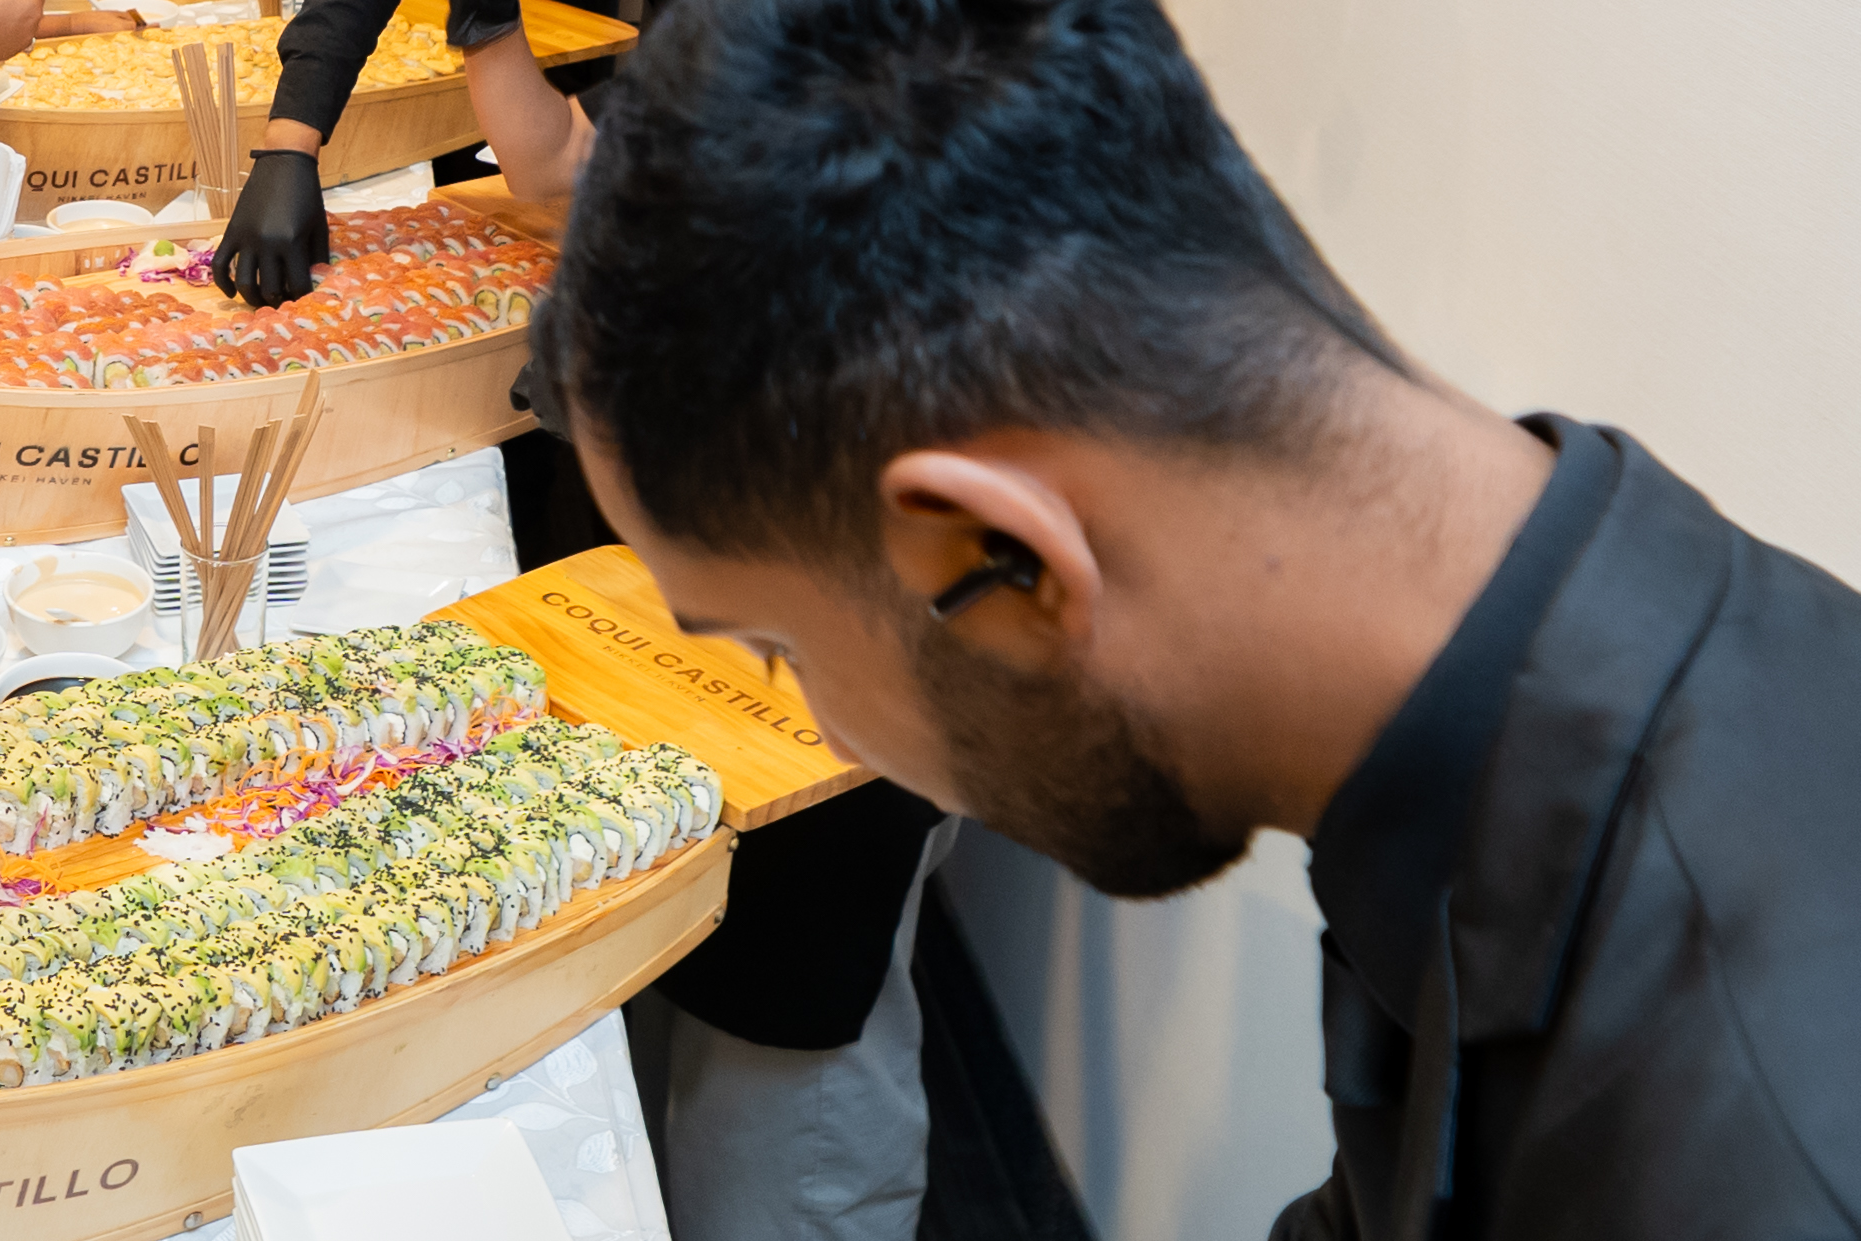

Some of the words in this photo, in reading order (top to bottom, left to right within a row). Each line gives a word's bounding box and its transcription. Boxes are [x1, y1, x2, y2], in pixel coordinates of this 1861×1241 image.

[26, 170, 78, 192] QUI
[89, 160, 198, 188] CASTILL
[15, 443, 199, 469] CASTILO
[35, 476, 92, 486] HAVEN
[541, 592, 652, 651] COQUI
[653, 652, 823, 747] CASTILLO
